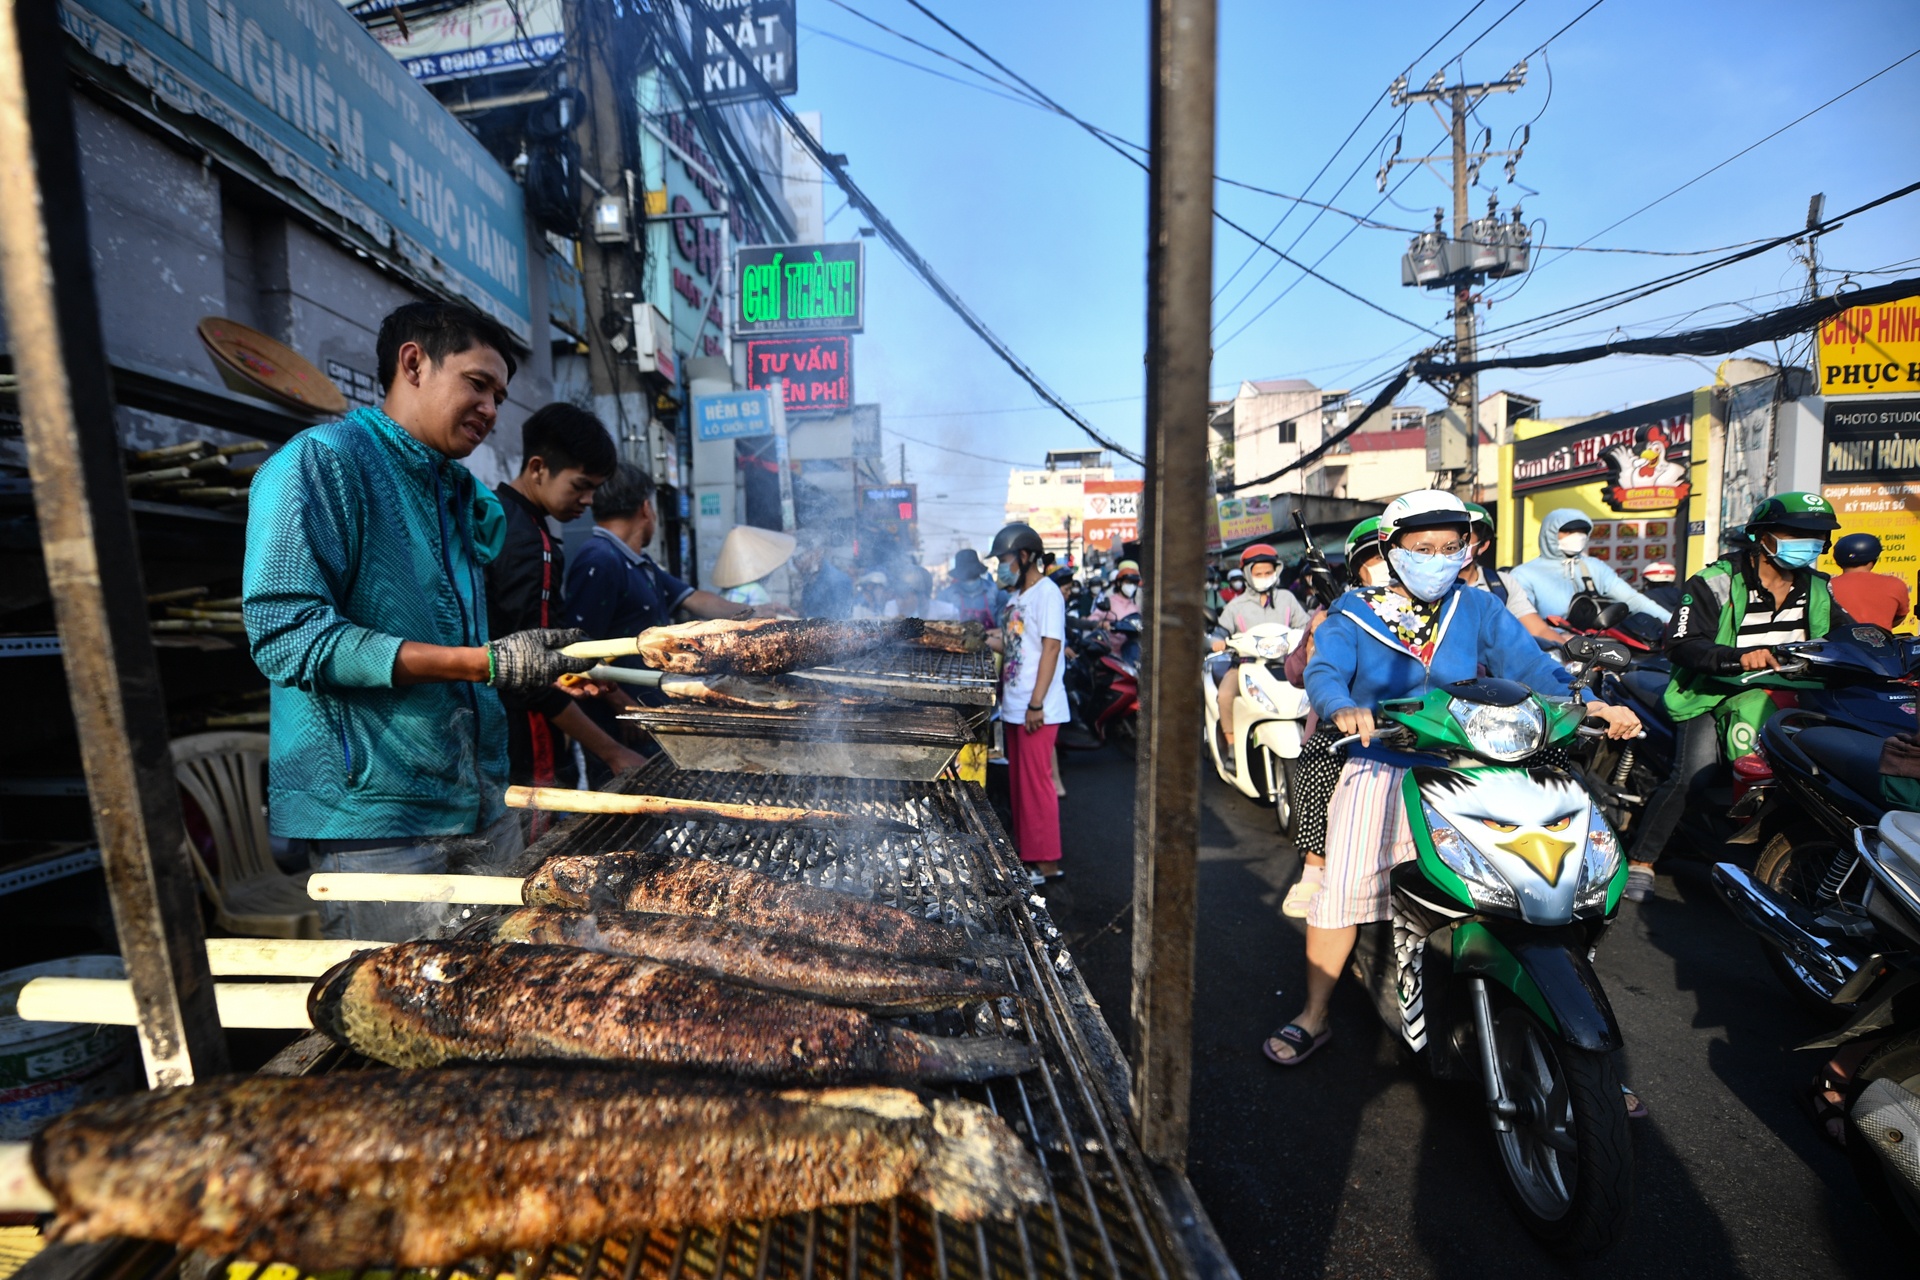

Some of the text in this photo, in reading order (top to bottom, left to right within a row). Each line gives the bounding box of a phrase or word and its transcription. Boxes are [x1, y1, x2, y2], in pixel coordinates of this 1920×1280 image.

[389, 140, 461, 251] THỰC
[463, 203, 521, 298] HÀNH
[743, 252, 783, 323] CHÍ
[784, 251, 856, 320] THÀNH
[758, 345, 838, 374] TƯ VẤN
[1826, 362, 1900, 389] PHỤC
[741, 401, 760, 417] 93
[1834, 412, 1878, 425] PHOTO
[1827, 440, 1875, 472] MINH
[1824, 487, 1849, 500] CHỤP
[1877, 485, 1901, 496] QUAY
[1860, 500, 1891, 513] THUẬT
[1892, 497, 1907, 511] SỐ
[1690, 522, 1704, 532] 92
[1884, 555, 1917, 564] TRANG
[1672, 605, 1690, 639] gojek
